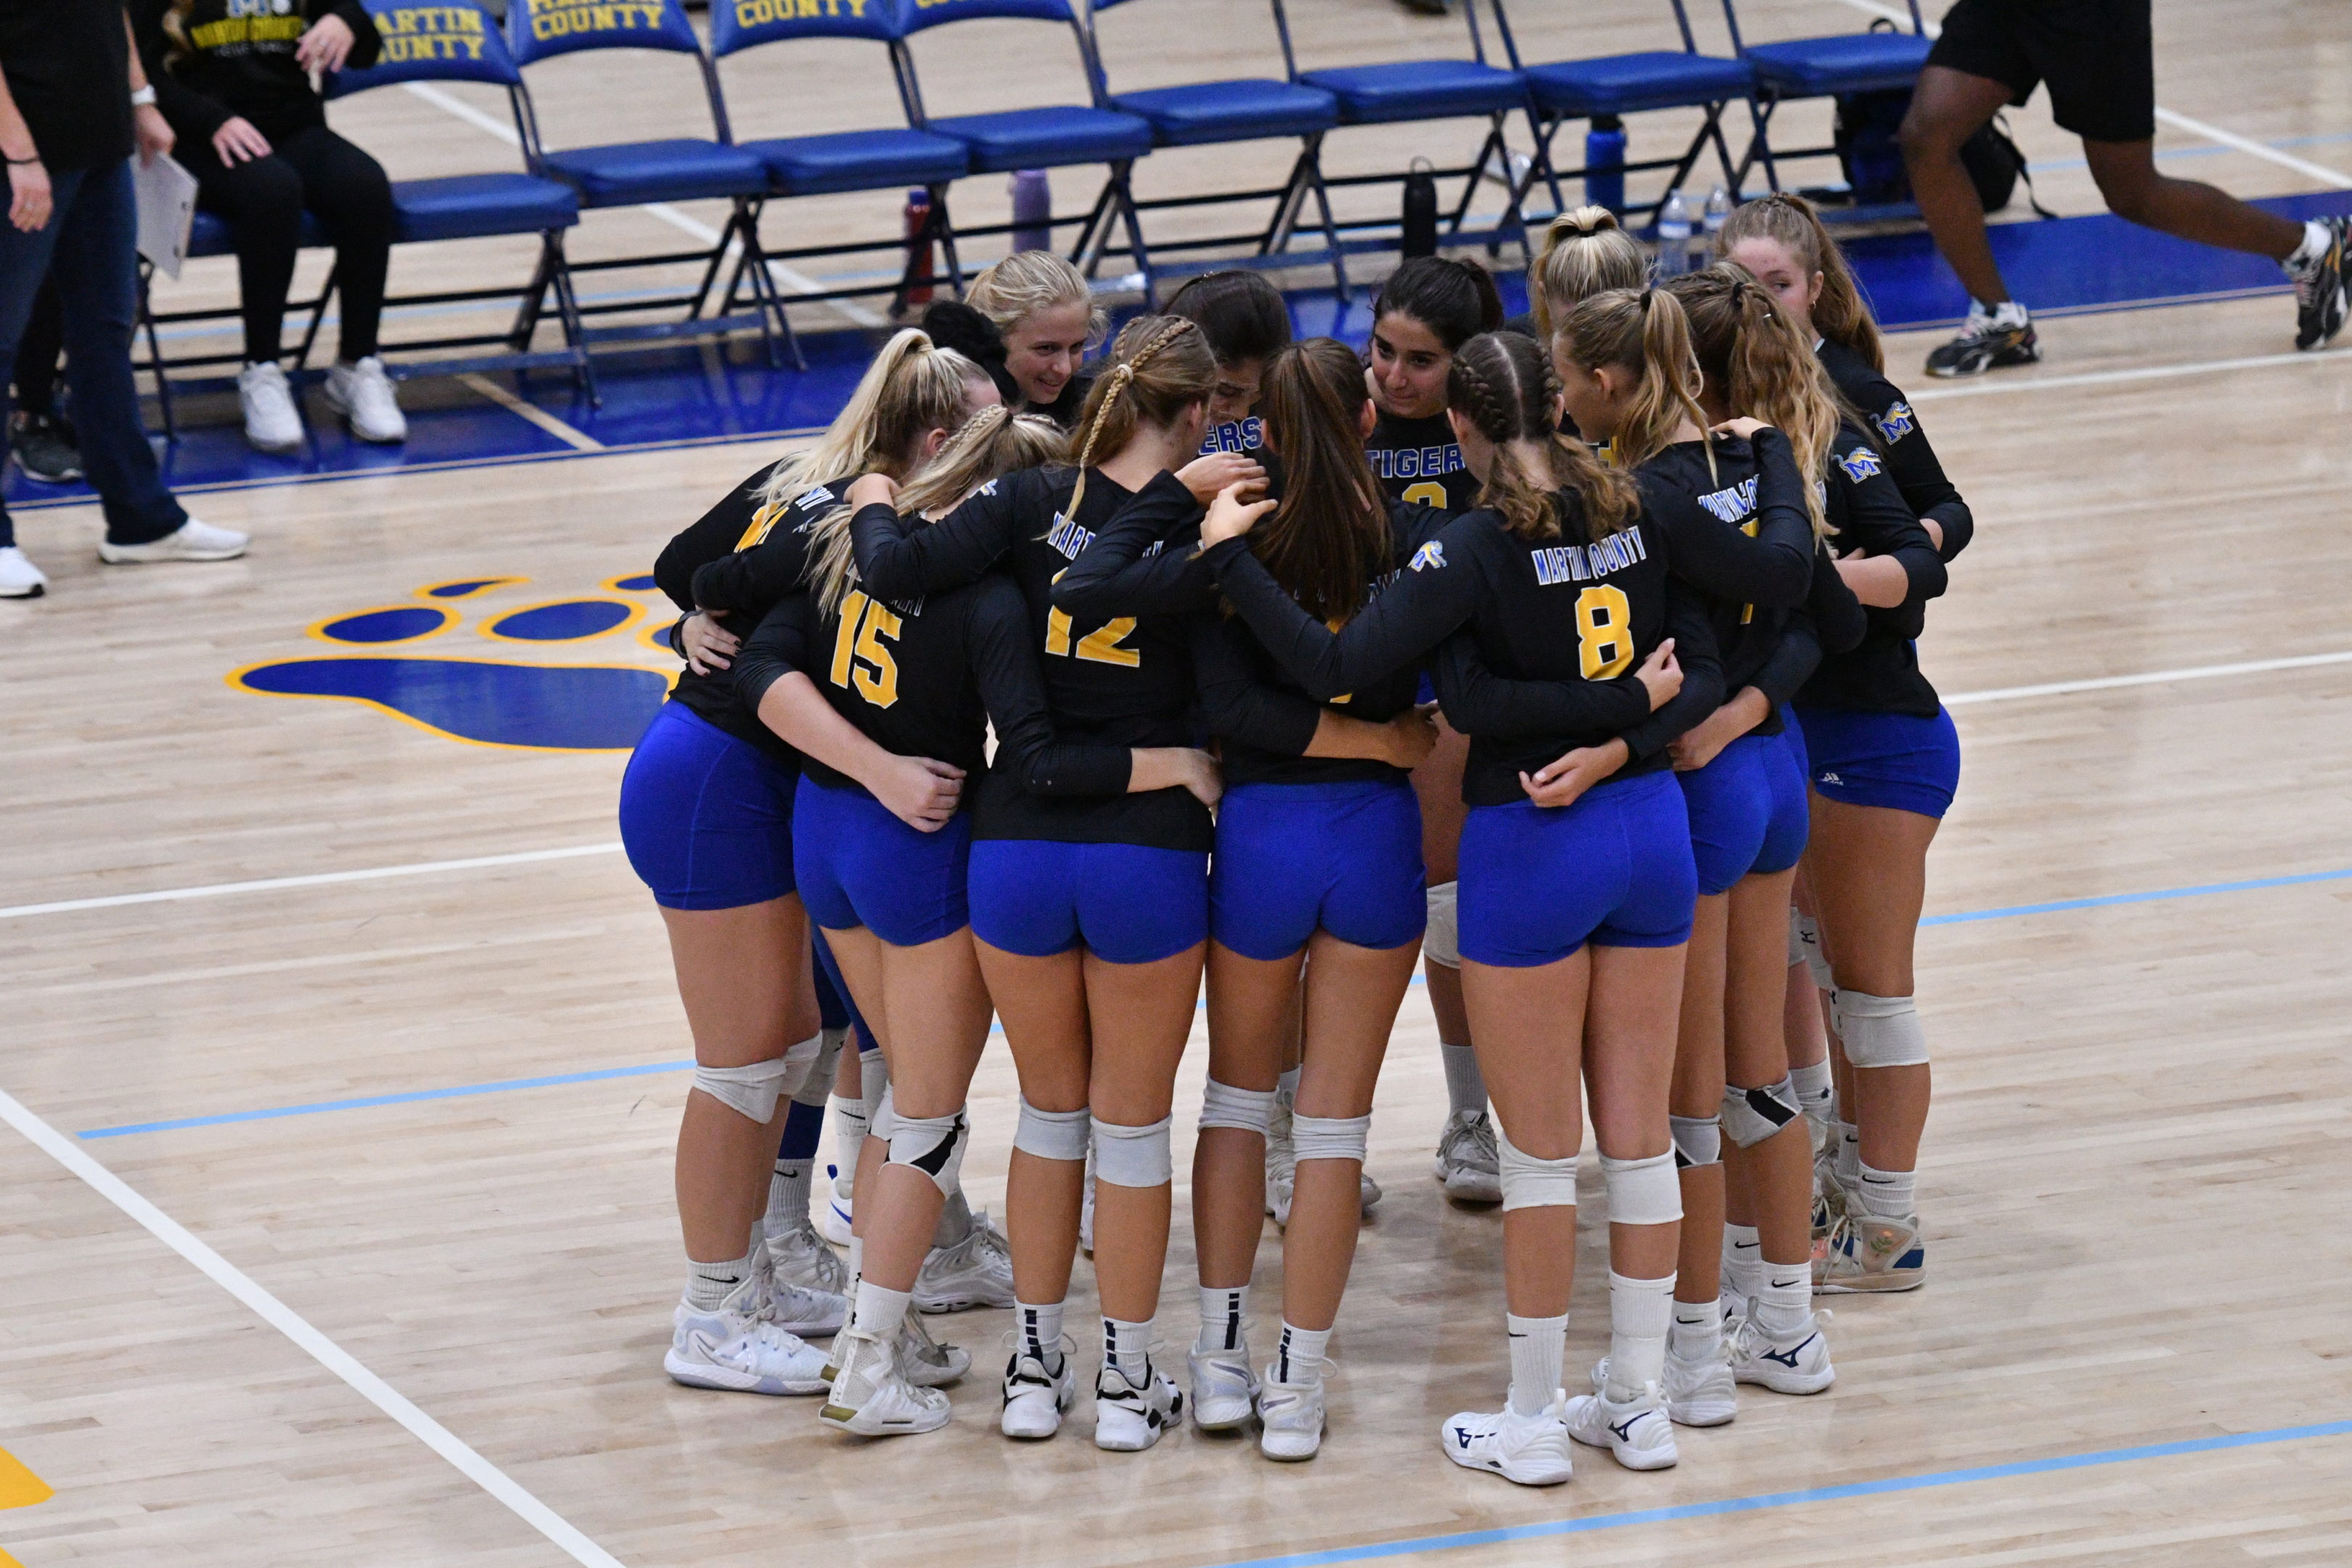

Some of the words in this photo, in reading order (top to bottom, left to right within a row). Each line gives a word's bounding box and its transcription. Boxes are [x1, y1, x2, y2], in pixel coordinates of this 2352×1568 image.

[373, 7, 483, 36] ARTIN
[531, 4, 663, 41] COUNTY
[375, 35, 485, 65] UNTY
[1198, 415, 1264, 456] ERS
[1363, 442, 1466, 479] TIGER
[1047, 510, 1097, 561] MART
[1530, 546, 1592, 587] MARTIN
[830, 588, 904, 710] 15
[1574, 583, 1635, 682] 8
